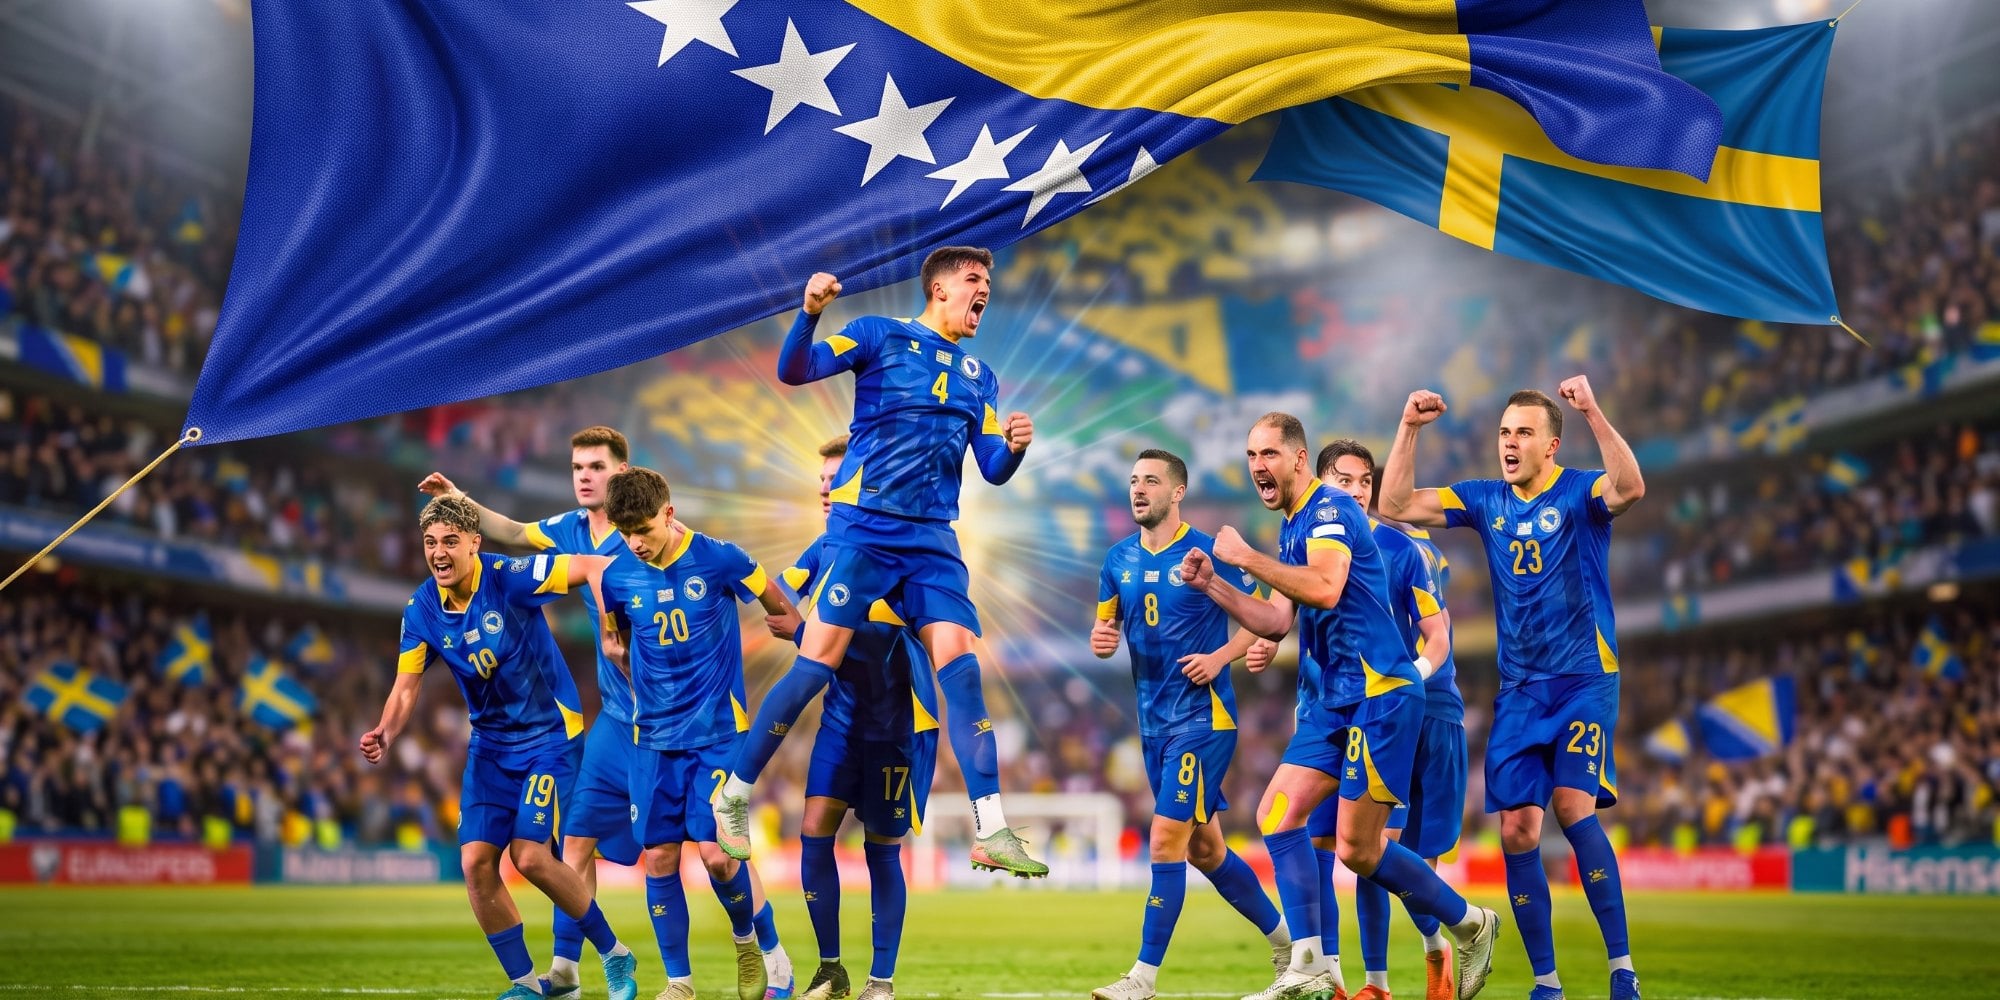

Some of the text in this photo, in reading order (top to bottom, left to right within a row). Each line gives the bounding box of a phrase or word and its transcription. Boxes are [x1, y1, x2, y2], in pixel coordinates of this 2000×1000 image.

[932, 371, 948, 404] 4
[1509, 540, 1543, 575] 23
[653, 608, 689, 645] 20
[1144, 593, 1159, 627] 8
[468, 648, 498, 679] 19
[1346, 726, 1362, 762] 8
[1567, 721, 1601, 756] 23
[882, 767, 909, 801] 17
[1178, 752, 1196, 785] 8
[525, 774, 555, 807] 19
[710, 769, 727, 804] 2
